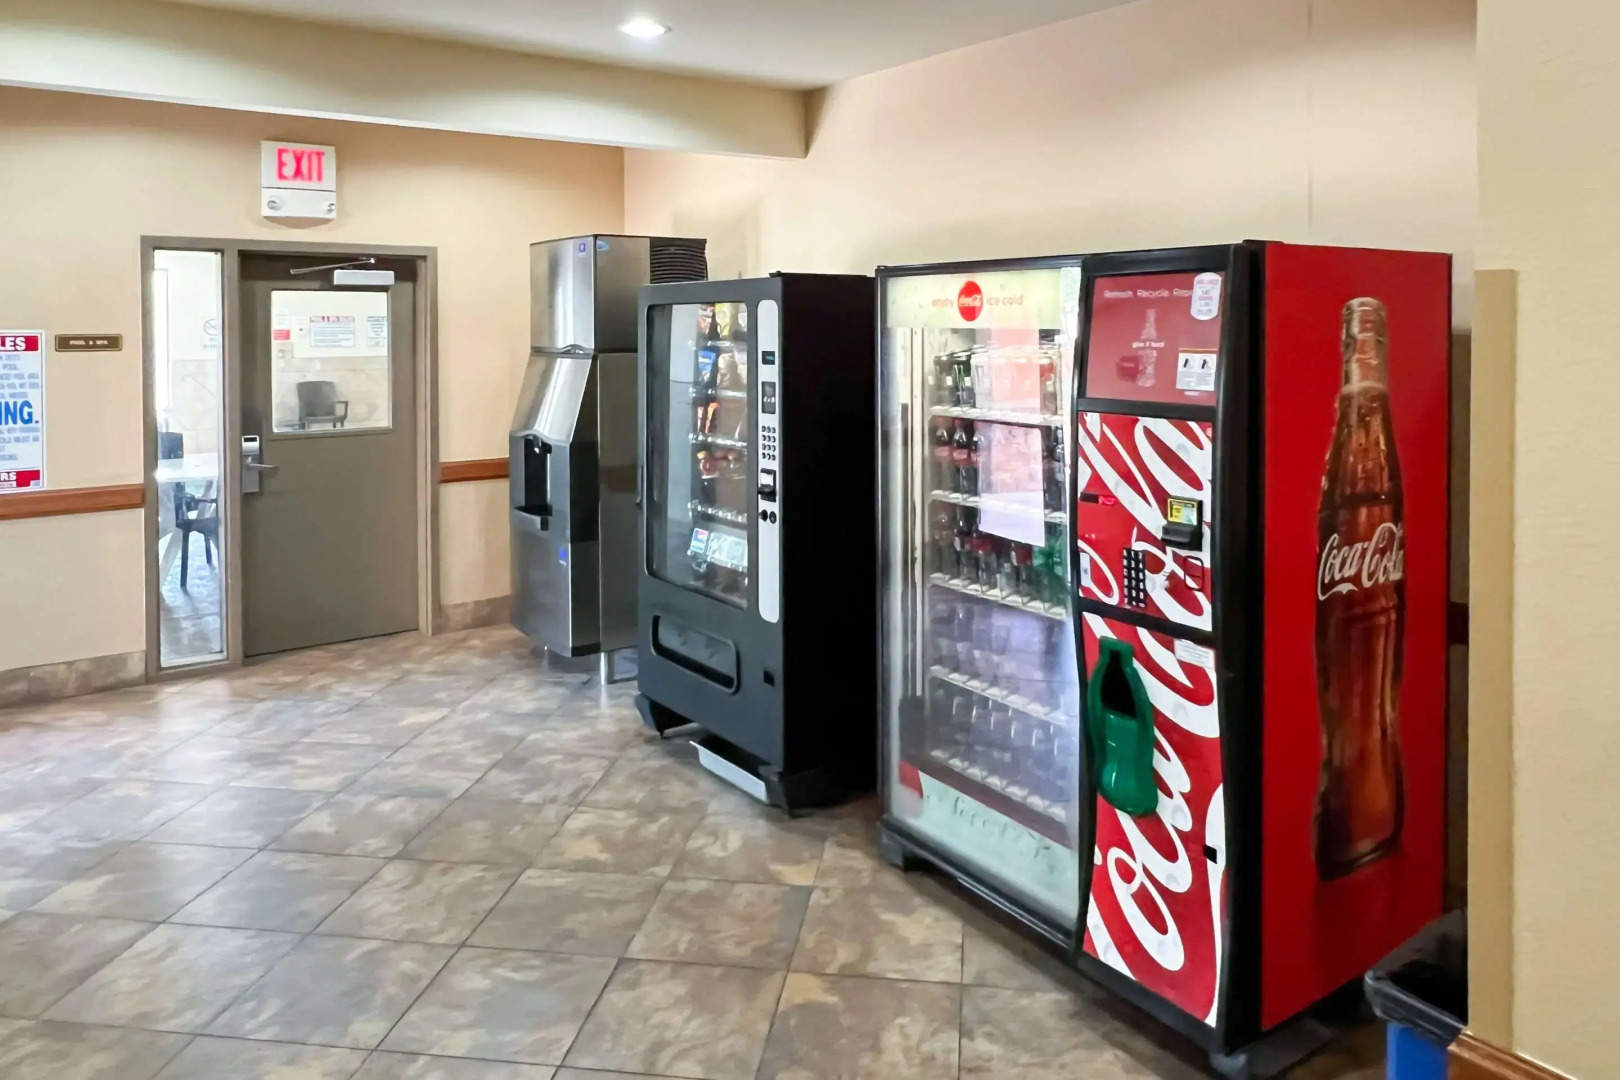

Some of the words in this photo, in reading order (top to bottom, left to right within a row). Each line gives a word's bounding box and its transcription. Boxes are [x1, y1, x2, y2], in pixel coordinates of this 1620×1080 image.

[276, 147, 325, 183] EXIT
[986, 296, 1000, 306] ice
[1002, 294, 1025, 306] cold
[1317, 522, 1404, 601] Coca-Cola
[1078, 412, 1221, 1027] ocaCola
